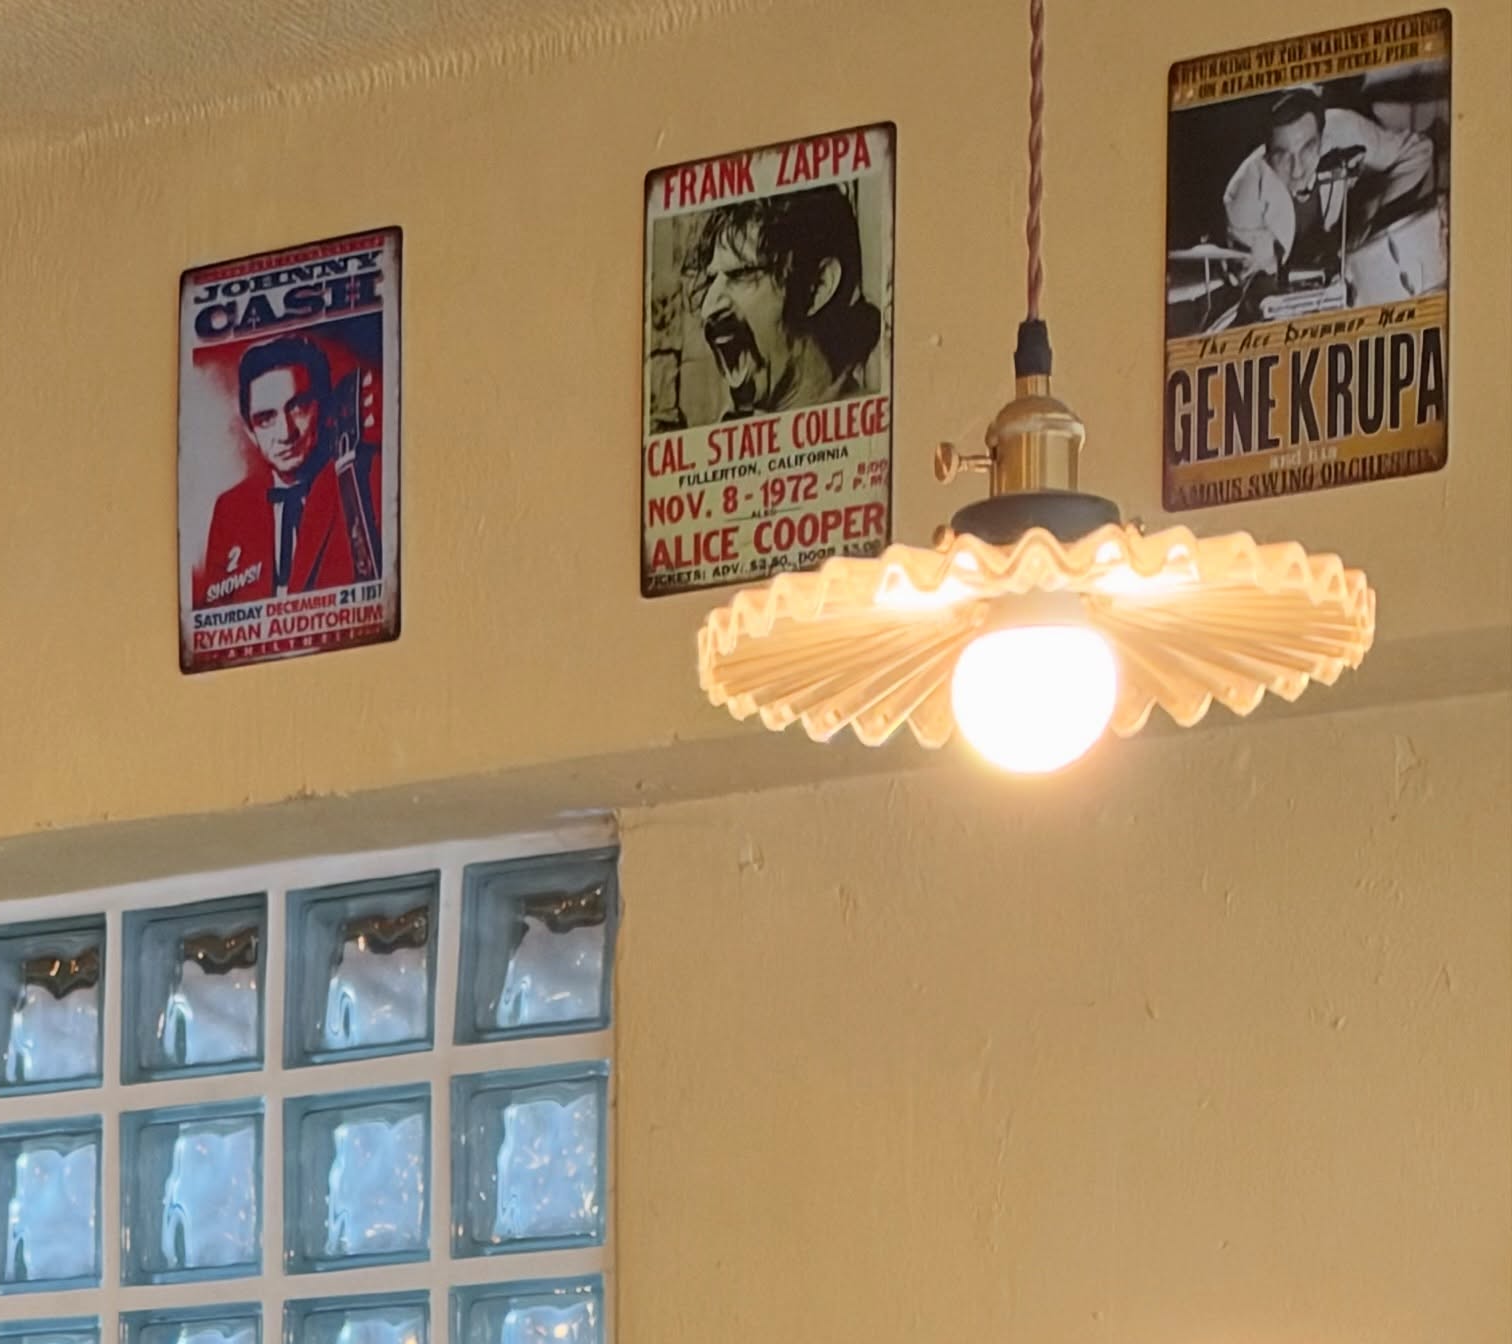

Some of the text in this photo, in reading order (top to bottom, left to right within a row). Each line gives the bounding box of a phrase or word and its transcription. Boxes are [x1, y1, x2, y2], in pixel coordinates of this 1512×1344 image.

[664, 130, 871, 211] FRANK ZAPPA
[193, 250, 384, 304] JOHNNY
[194, 269, 385, 340] CASH
[1198, 336, 1228, 359] The
[1238, 329, 1271, 353] Ace
[1378, 306, 1417, 327] Man
[1167, 326, 1446, 466] GENE KRUPA
[647, 397, 888, 477] CAL. STATE COLLEGE
[768, 446, 849, 471] CALIFORNIA
[648, 472, 818, 528] NOV. 8 1972
[226, 546, 241, 572] 2
[651, 502, 884, 573] ALICE COOPER
[194, 605, 263, 629] SATURDAY
[340, 589, 356, 605] 21
[206, 562, 262, 602] SHOWS!
[194, 622, 261, 650] RYMAN
[267, 604, 383, 639] AUDITORIUM
